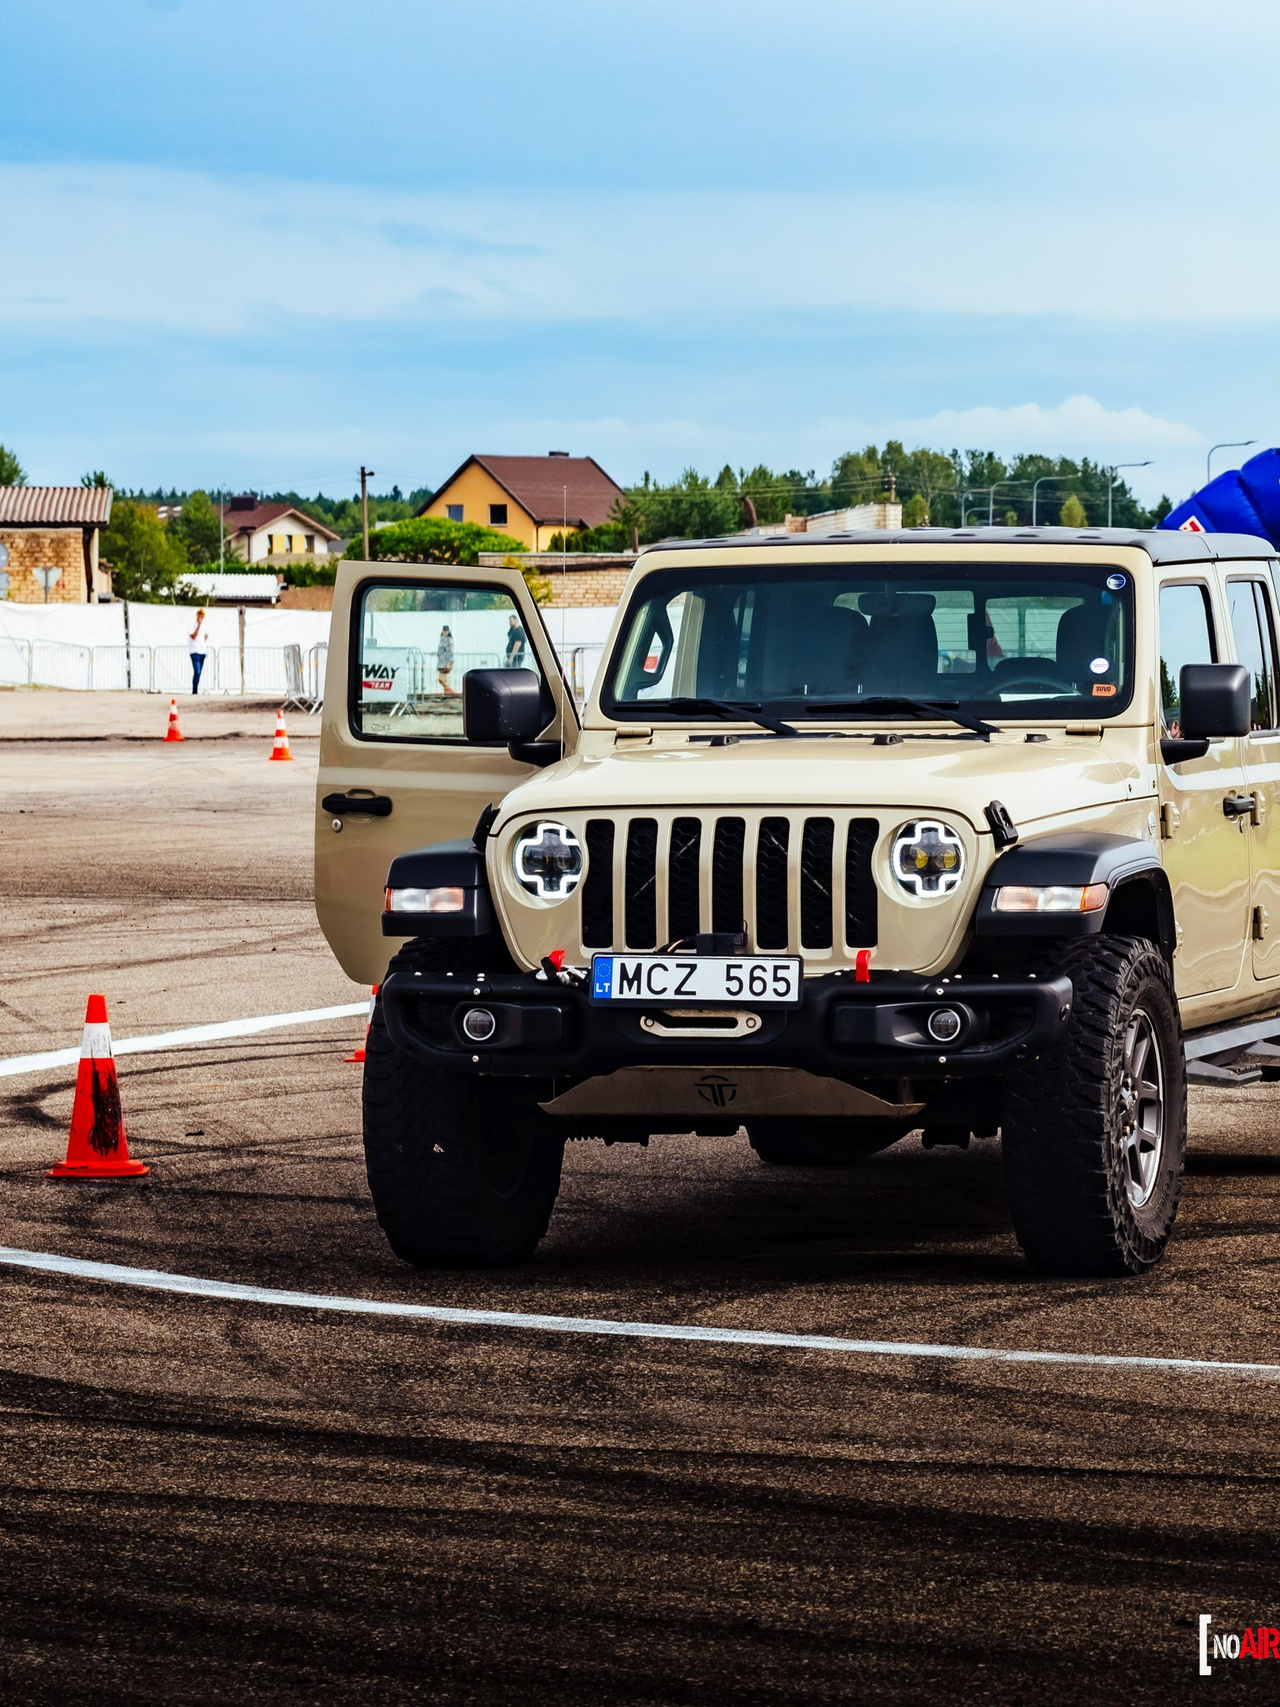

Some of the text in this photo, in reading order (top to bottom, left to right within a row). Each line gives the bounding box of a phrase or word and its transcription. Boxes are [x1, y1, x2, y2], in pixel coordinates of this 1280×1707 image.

[596, 982, 610, 993] LT
[618, 962, 792, 997] MCZ 565
